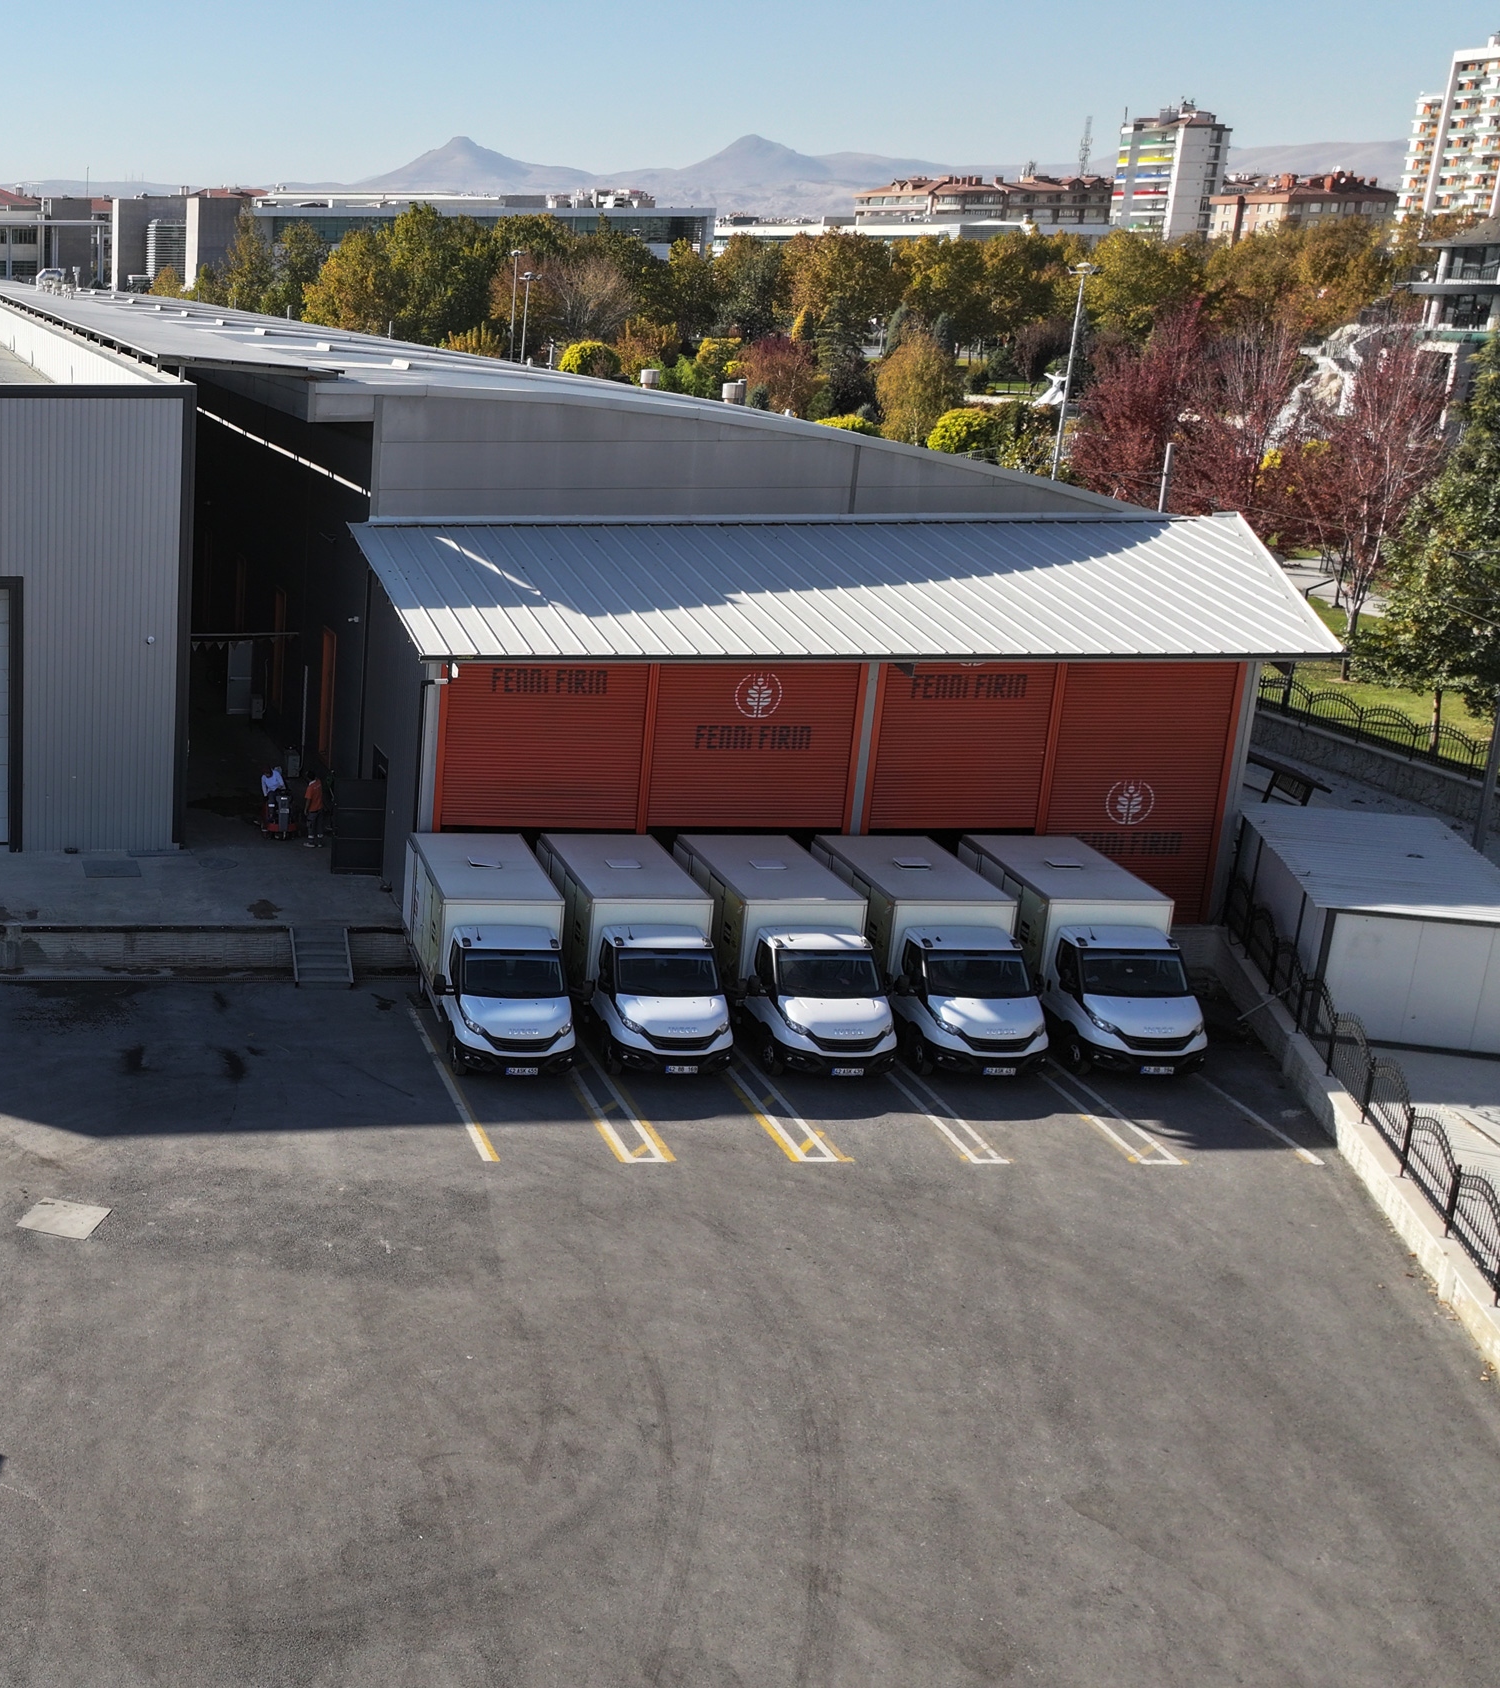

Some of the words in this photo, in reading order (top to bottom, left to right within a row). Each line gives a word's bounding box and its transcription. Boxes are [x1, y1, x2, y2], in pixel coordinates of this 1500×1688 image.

[556, 669, 608, 694] FIRIN
[974, 673, 1028, 699] FIRIN
[758, 725, 812, 749] FIRIN
[668, 1026, 699, 1034] IVECO
